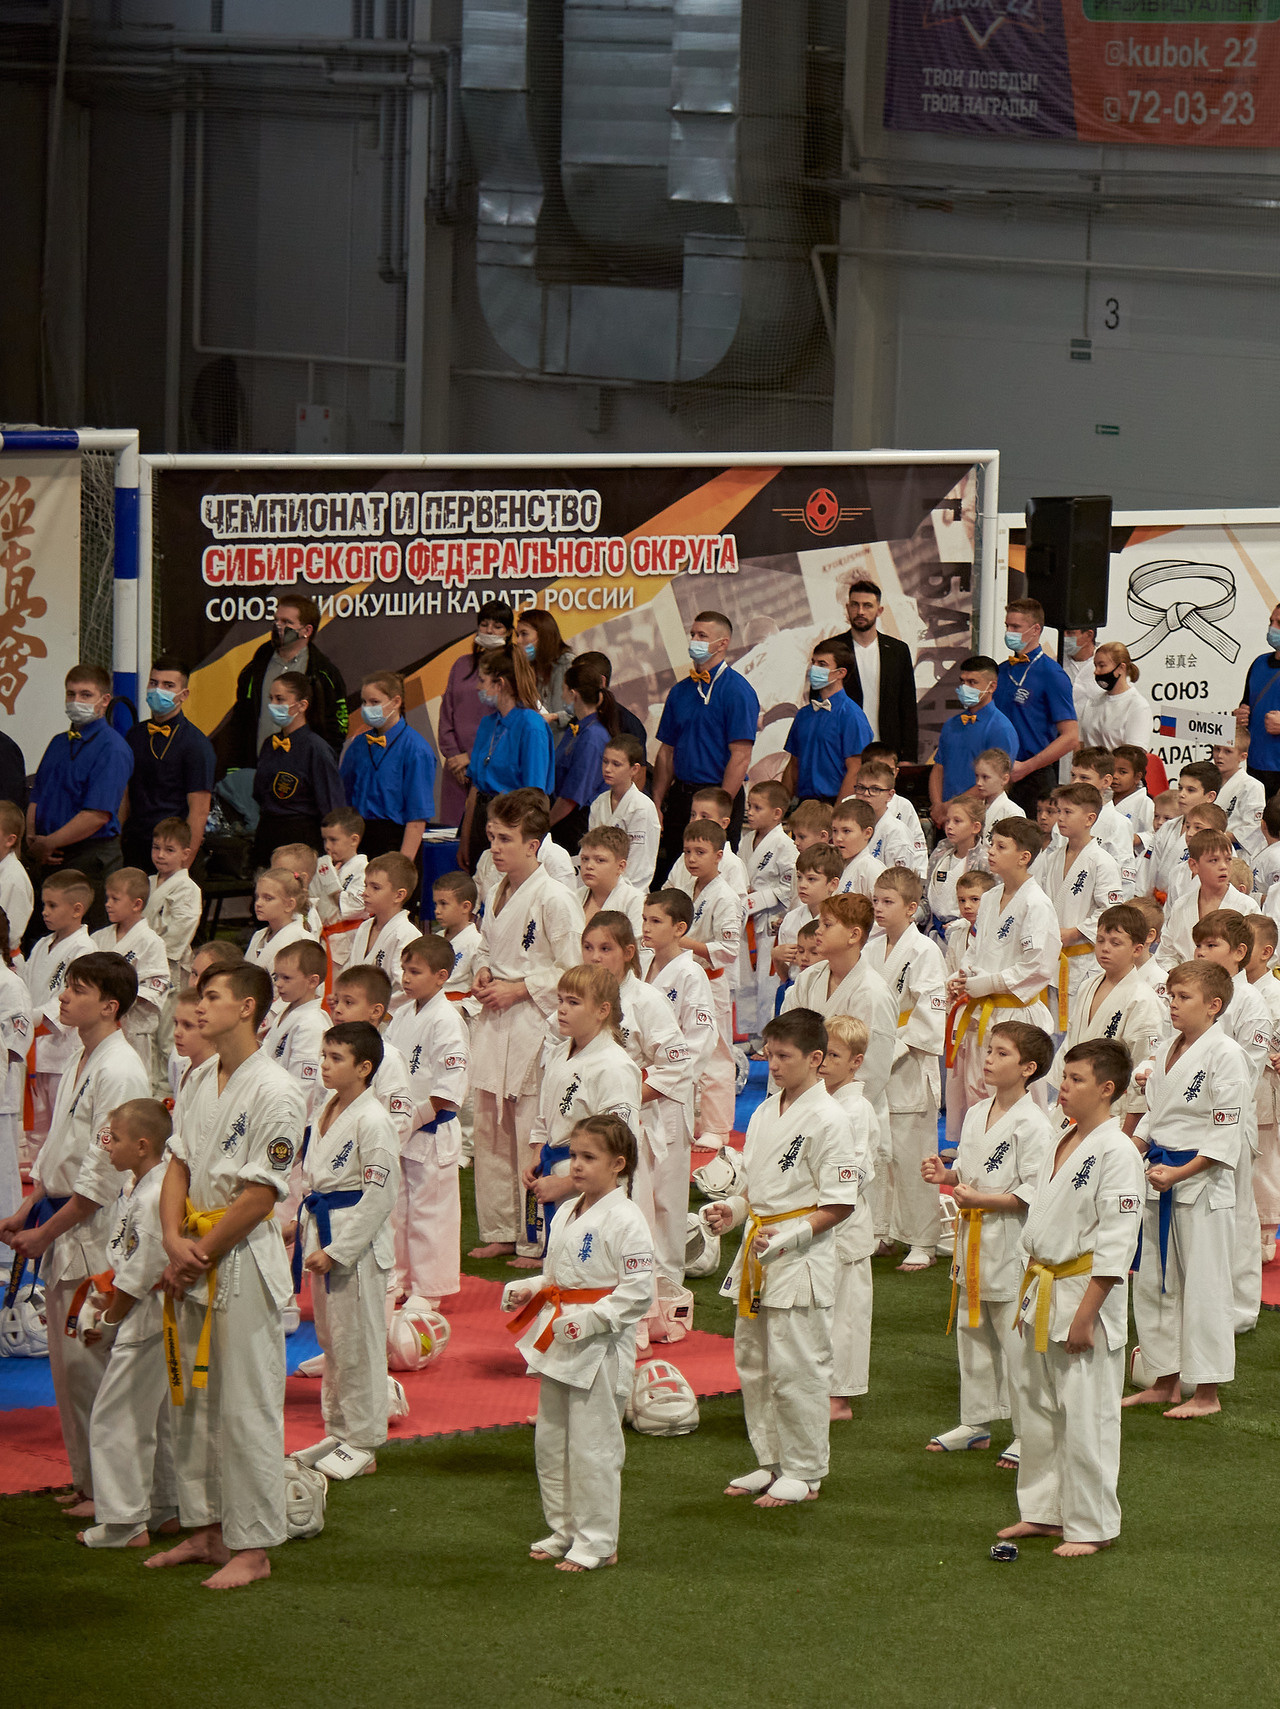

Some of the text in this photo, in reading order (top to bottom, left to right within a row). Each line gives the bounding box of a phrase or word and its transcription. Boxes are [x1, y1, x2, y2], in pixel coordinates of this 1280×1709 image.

[1127, 37, 1258, 72] kubok_22
[1127, 90, 1256, 125] 72-03-23
[1105, 298, 1119, 329] 3
[201, 490, 601, 538] ЧЕМПИОНАТ И ПЕРВЕНСТВО
[203, 534, 739, 588] СИБИРСКОГО ФЕДЕРАЛЬНОГО ОКРУГА
[205, 596, 281, 622] СОЮЗ
[312, 592, 442, 618] ИОКУШИН
[544, 586, 634, 611] РОССИИ
[1151, 680, 1209, 702] СОЮЗ
[1188, 719, 1223, 736] OMSK
